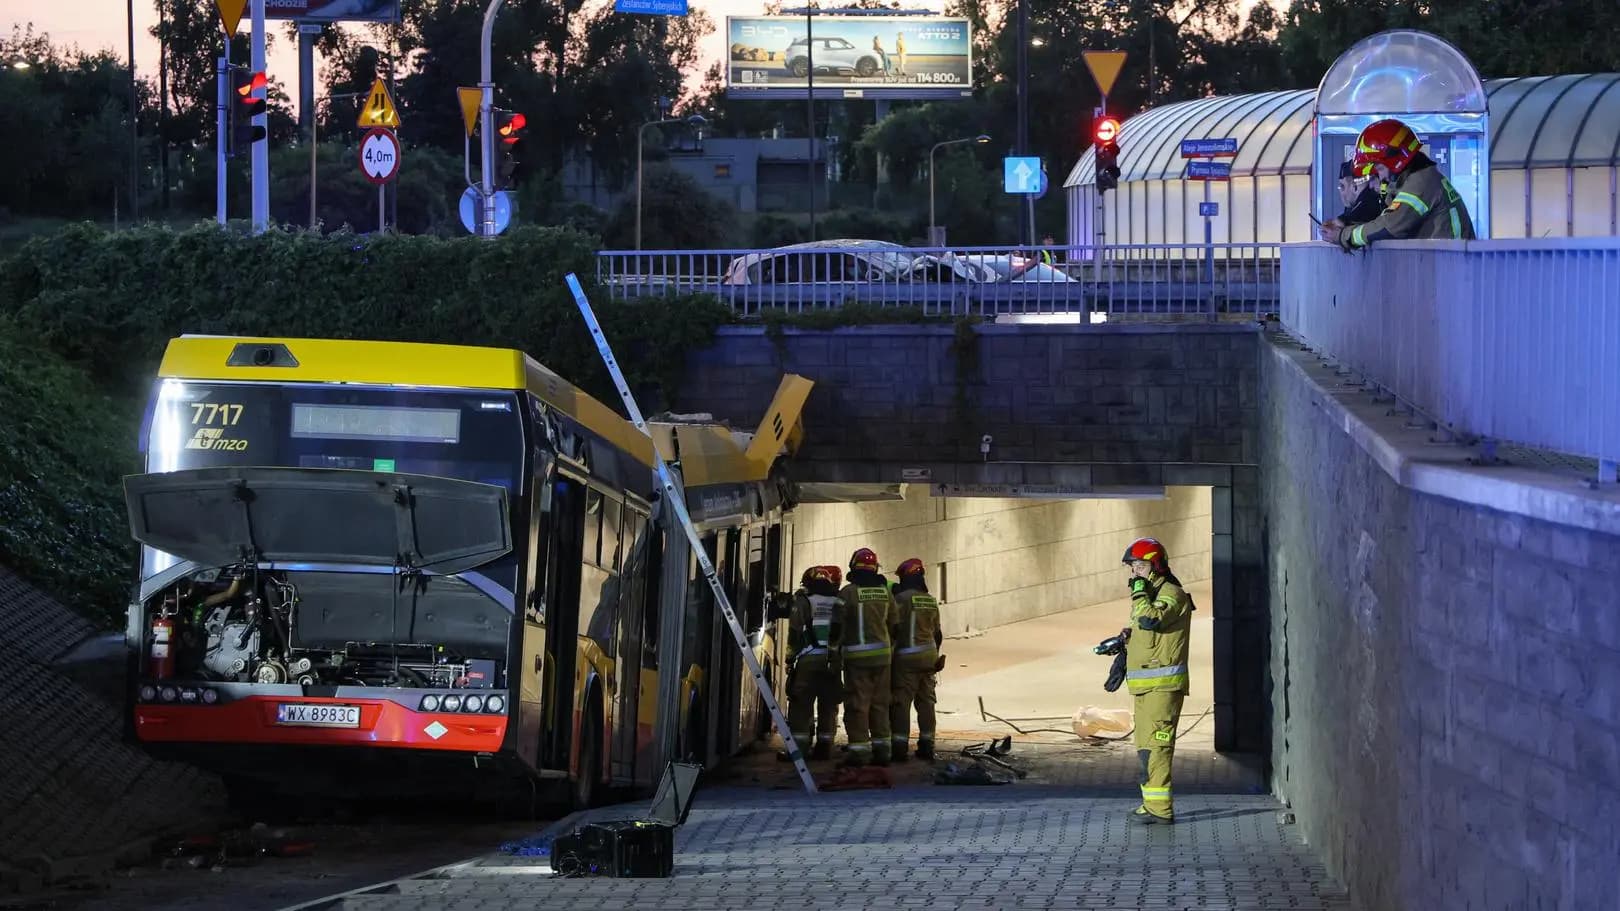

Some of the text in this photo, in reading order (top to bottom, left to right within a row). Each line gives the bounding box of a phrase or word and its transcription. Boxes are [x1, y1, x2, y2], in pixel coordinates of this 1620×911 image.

[951, 32, 960, 40] 2
[917, 72, 932, 82] 114
[933, 72, 954, 82] 800
[365, 147, 393, 165] 4,0m
[190, 403, 244, 426] 7717
[212, 438, 248, 451] mza
[288, 706, 306, 722] WX
[311, 708, 356, 722] 8983C
